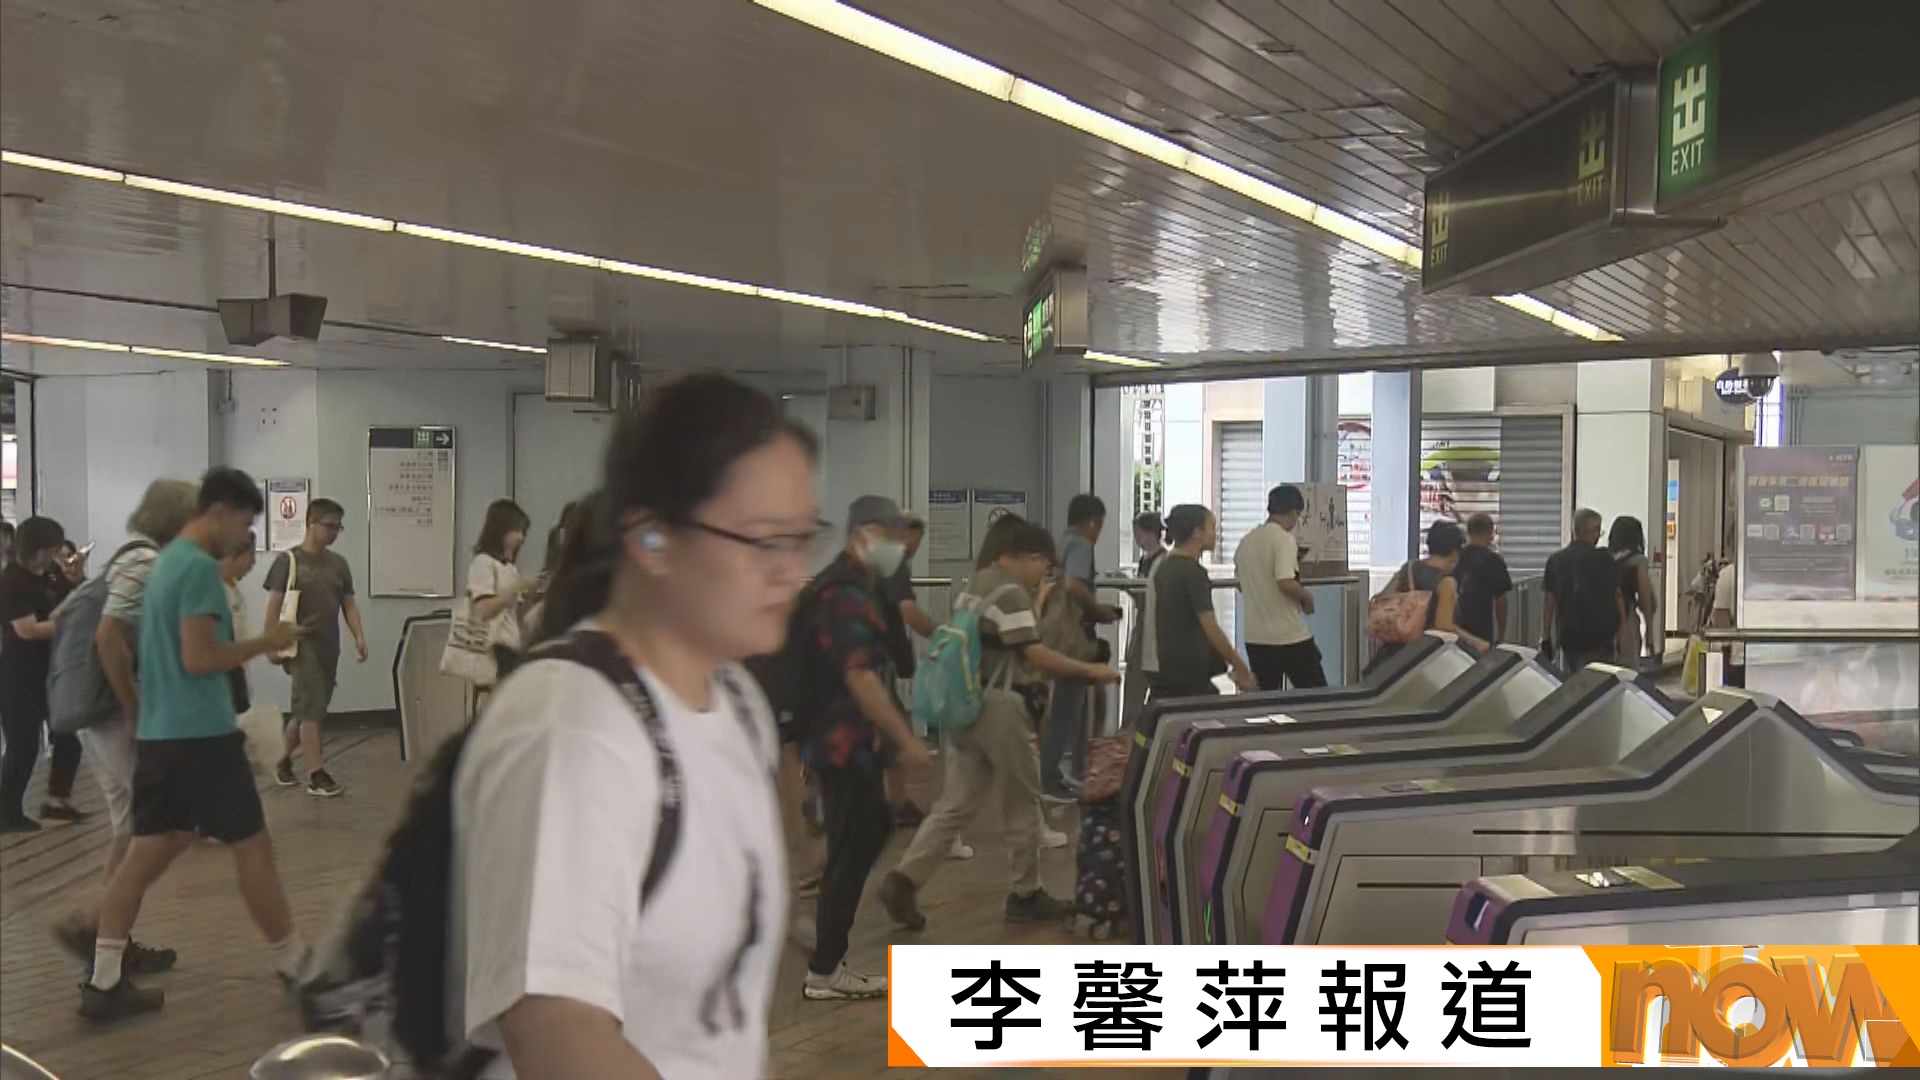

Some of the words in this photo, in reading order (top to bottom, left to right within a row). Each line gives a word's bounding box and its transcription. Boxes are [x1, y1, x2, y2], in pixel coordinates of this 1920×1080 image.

[1672, 63, 1707, 147] 出
[1671, 137, 1705, 176] EXIT
[1577, 173, 1604, 207] EXIT
[1430, 242, 1448, 267] EXIT
